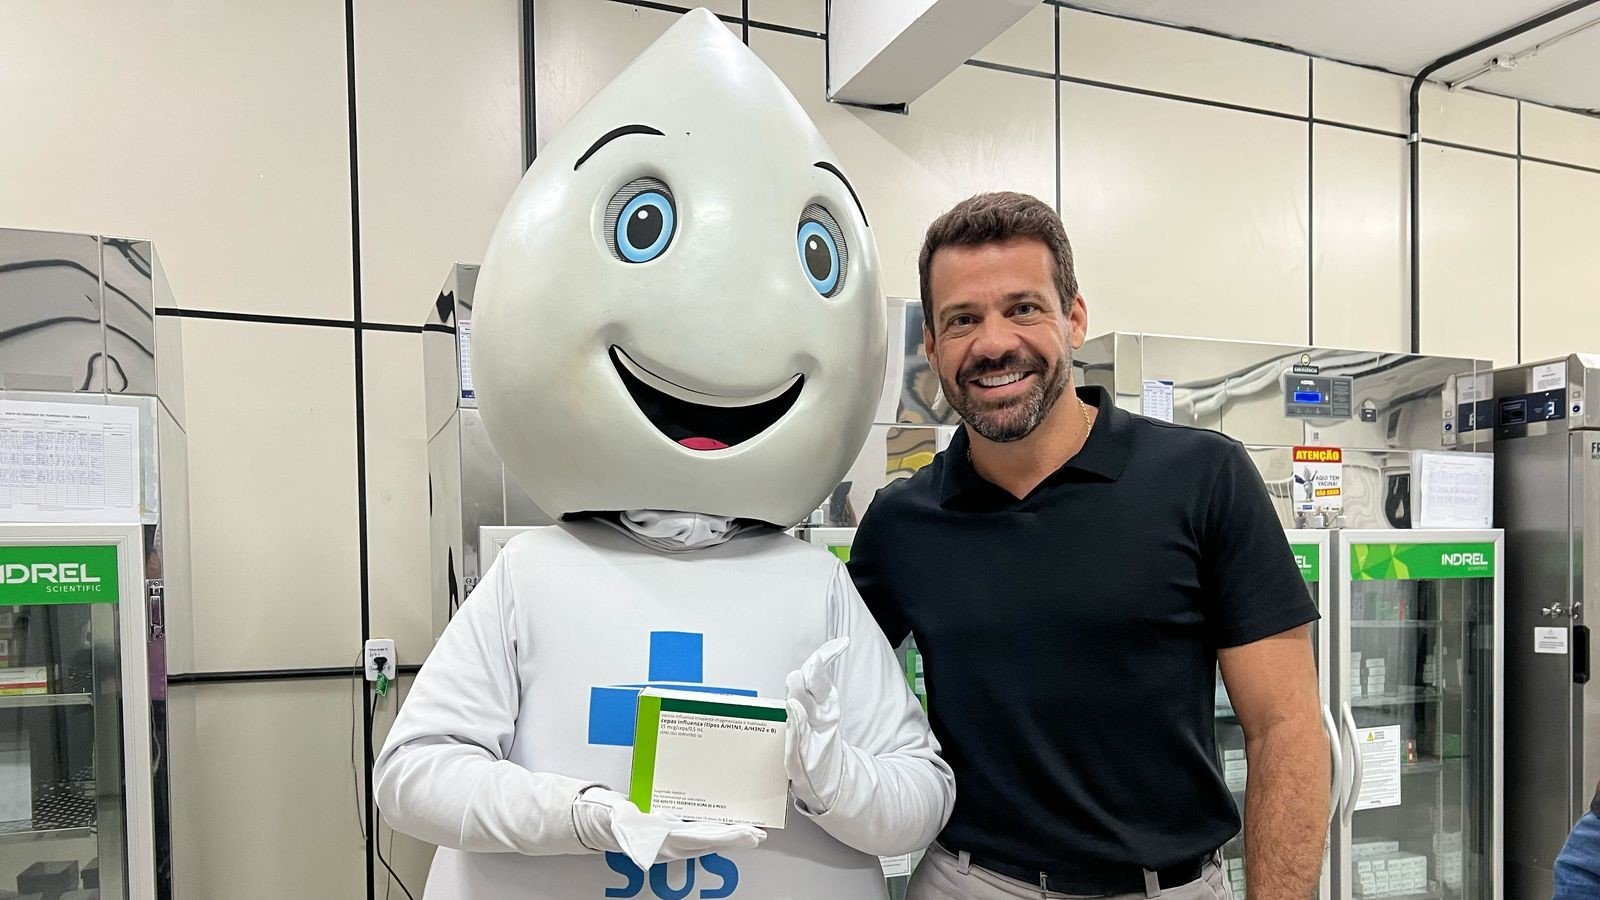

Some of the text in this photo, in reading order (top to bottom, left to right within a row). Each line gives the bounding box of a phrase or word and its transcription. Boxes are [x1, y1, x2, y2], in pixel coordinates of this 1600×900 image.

[1295, 449, 1340, 461] ATENÇÃO
[1441, 553, 1489, 566] INDREL
[0, 563, 101, 584] DREL
[46, 585, 101, 593] SCIENTIFIC
[677, 719, 703, 727] influenza
[744, 725, 765, 733] A/H3N2
[605, 851, 739, 900] SUS
